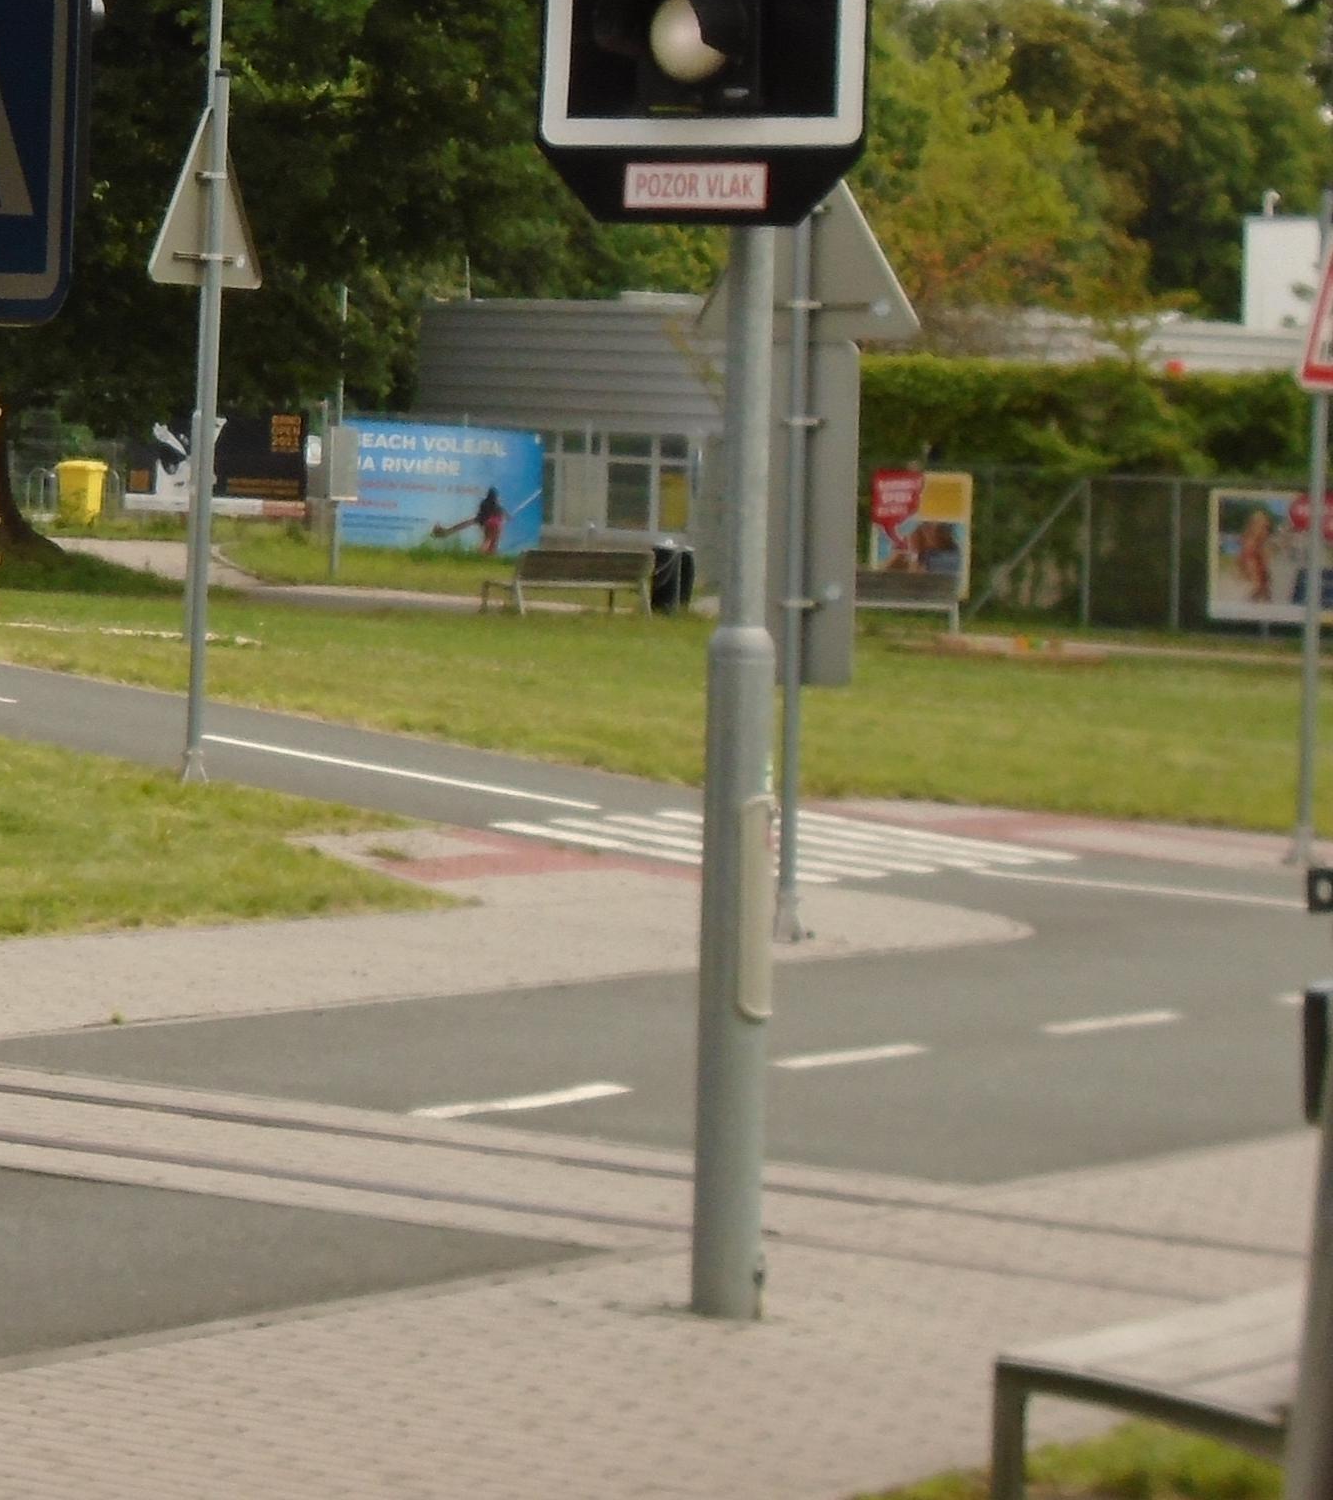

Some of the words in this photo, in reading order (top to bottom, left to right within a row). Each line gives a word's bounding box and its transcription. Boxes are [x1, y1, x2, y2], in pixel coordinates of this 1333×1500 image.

[635, 173, 699, 198] POZOR
[706, 173, 754, 198] VLAK
[358, 433, 416, 451] EACH
